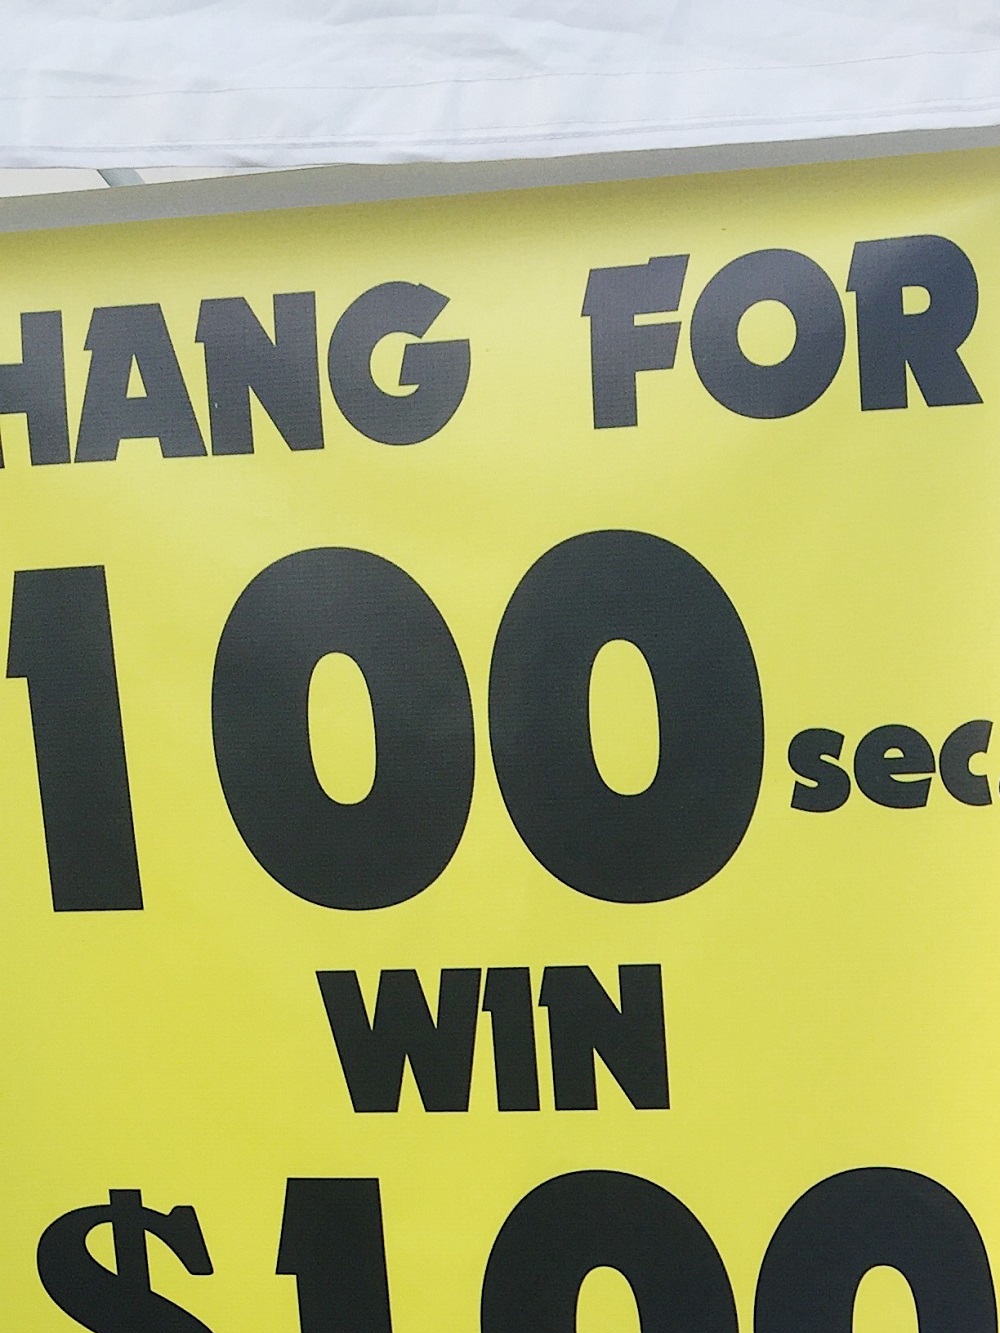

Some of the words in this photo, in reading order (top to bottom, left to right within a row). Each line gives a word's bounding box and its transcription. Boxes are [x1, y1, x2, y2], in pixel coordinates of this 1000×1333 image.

[580, 233, 984, 430] FOR
[5, 529, 764, 911] 100
[315, 963, 671, 1113] WIN
